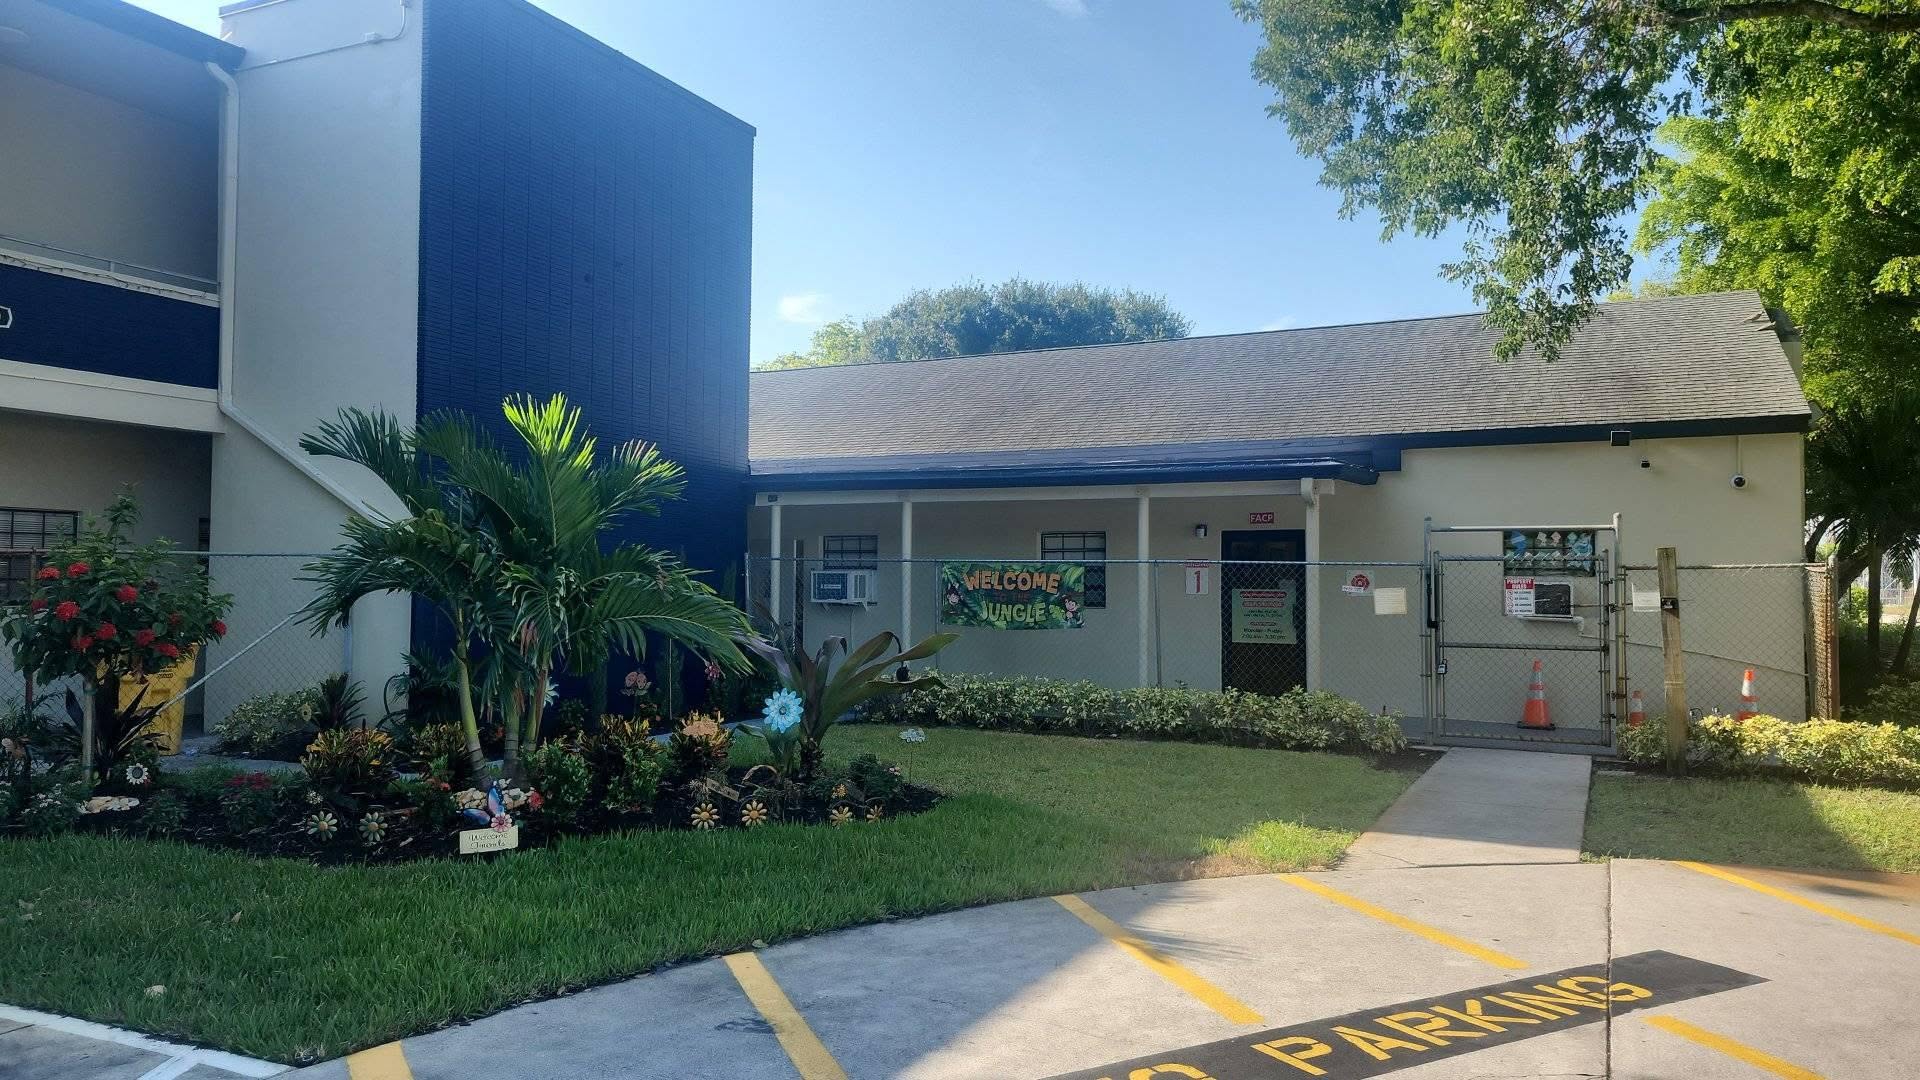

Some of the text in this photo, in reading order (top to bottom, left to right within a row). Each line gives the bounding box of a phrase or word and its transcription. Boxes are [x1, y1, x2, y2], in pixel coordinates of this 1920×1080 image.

[1250, 514, 1273, 522] FACP
[962, 570, 1061, 594] WELCOME
[1194, 570, 1201, 593] 1
[977, 601, 1047, 623] JUNGLE
[1251, 976, 1653, 1076] PARKING
